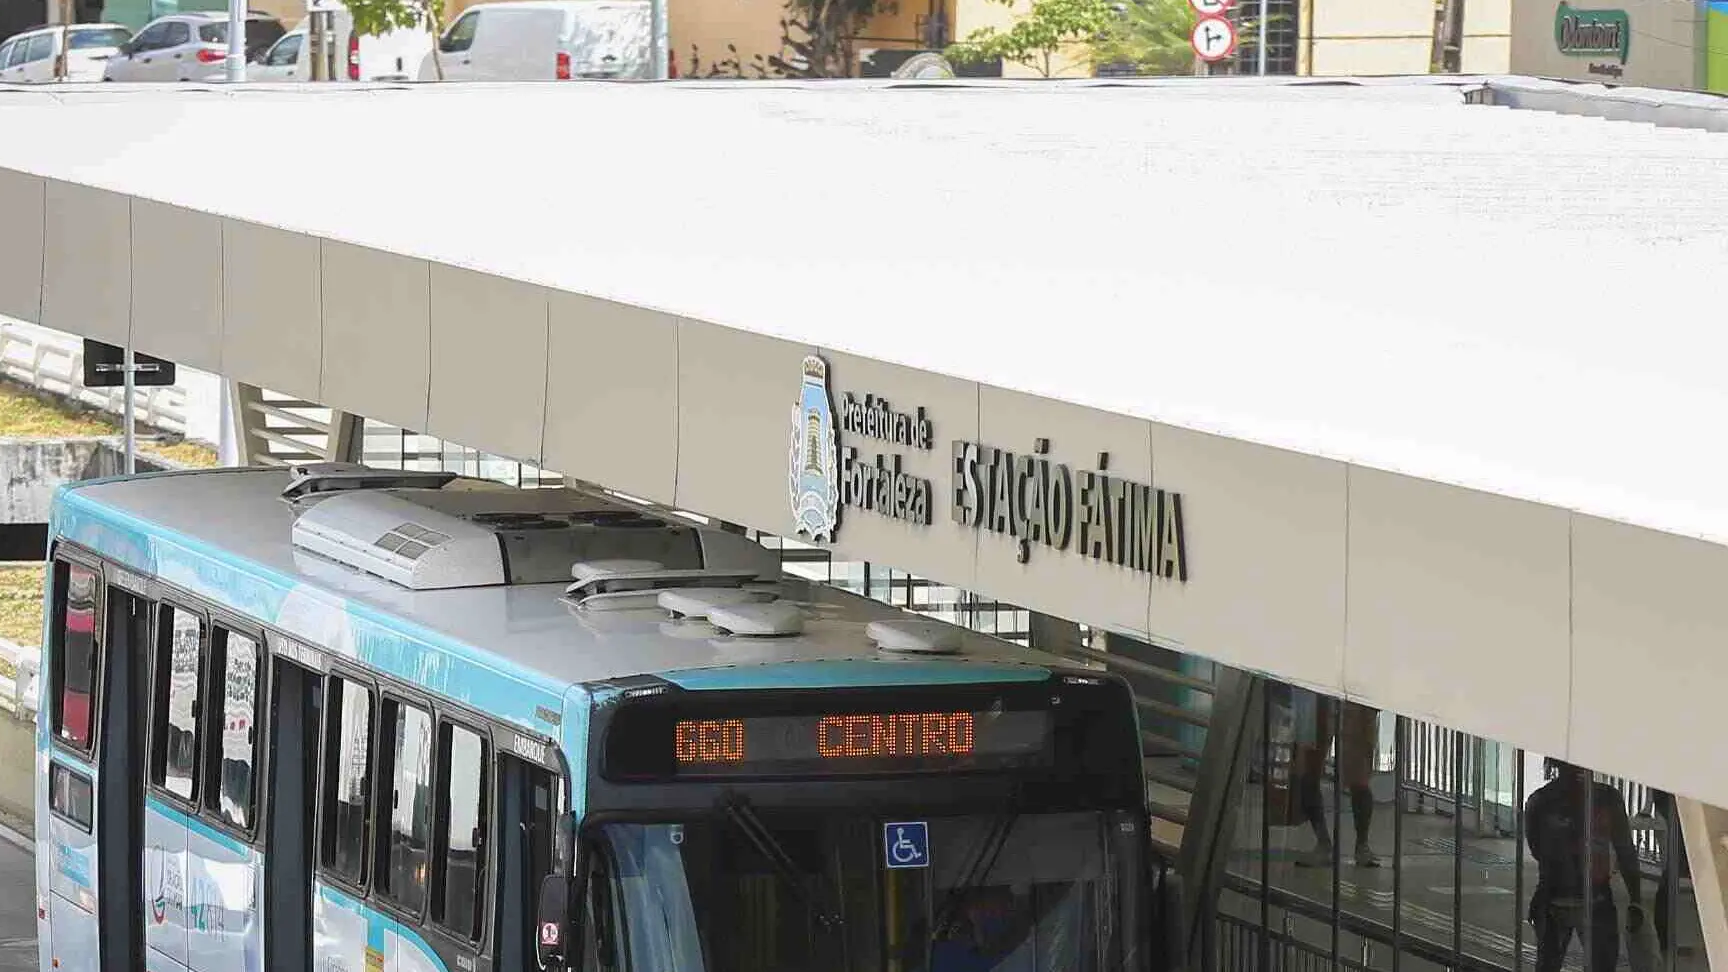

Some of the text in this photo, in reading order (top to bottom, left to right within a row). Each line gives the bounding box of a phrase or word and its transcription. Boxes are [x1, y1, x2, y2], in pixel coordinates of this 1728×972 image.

[841, 390, 933, 450] Prefeitura de
[840, 444, 933, 526] Fortaleza
[951, 437, 1188, 582] ESTAÇÃO FÁTIMA
[675, 712, 973, 762] 660 CENTRO
